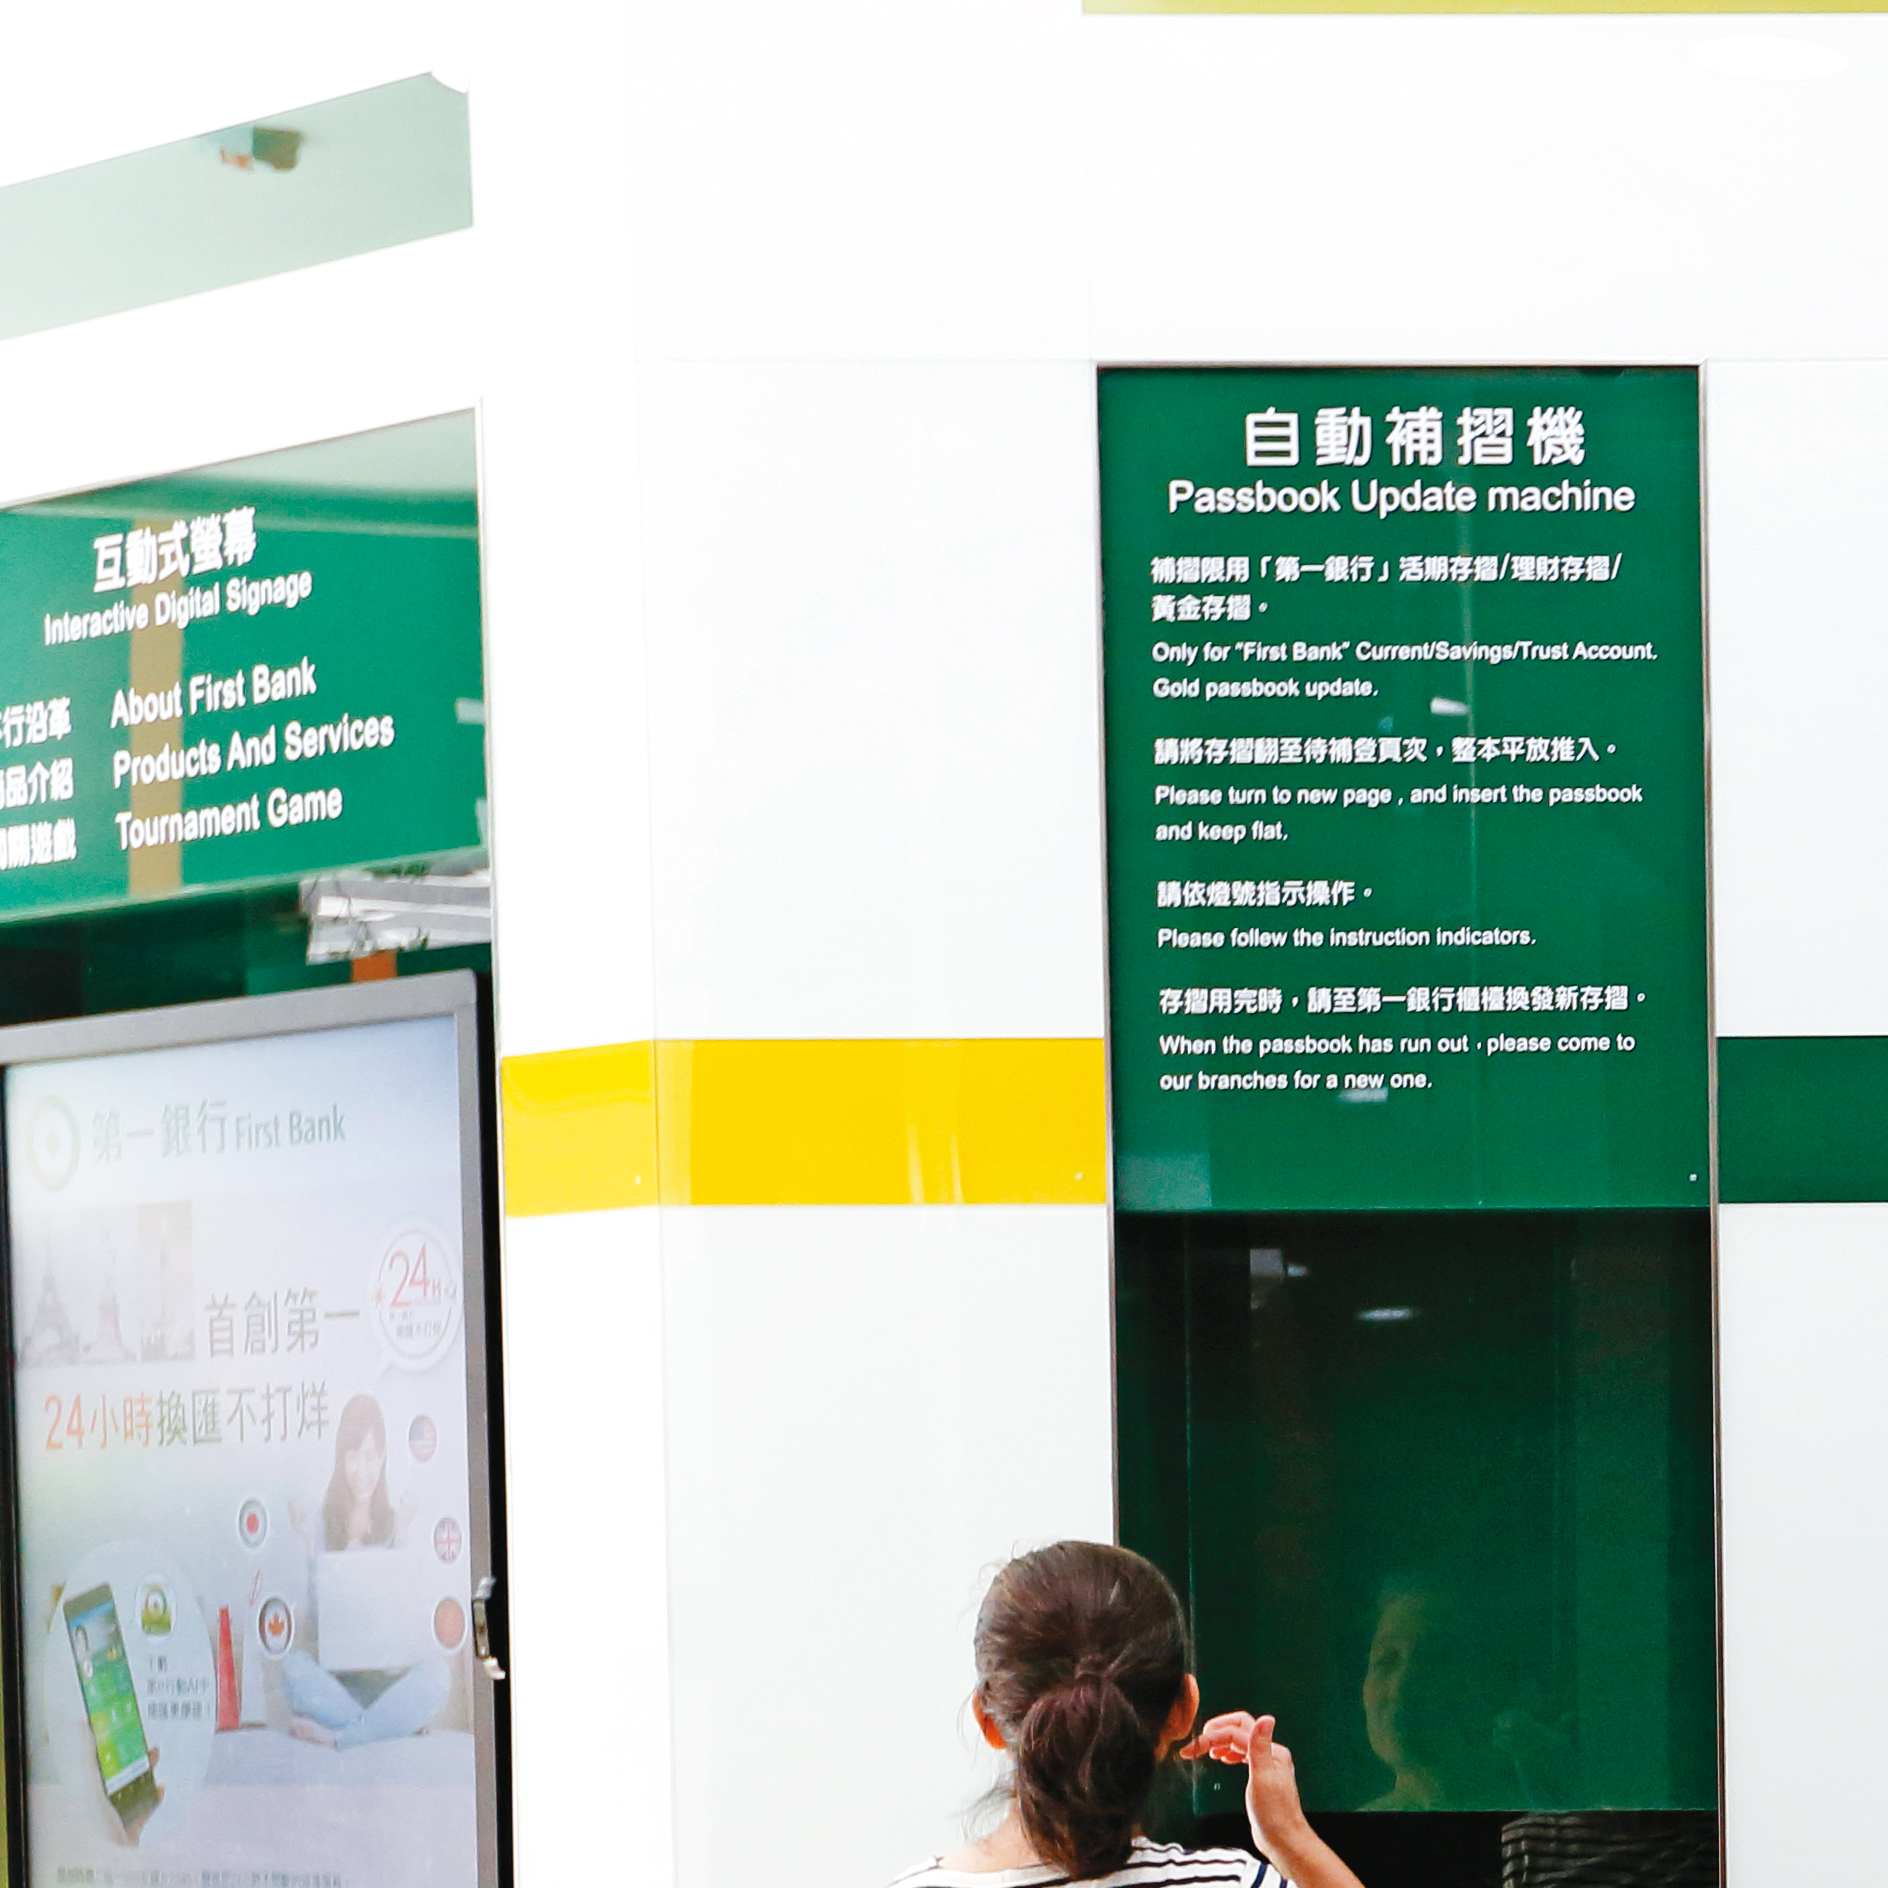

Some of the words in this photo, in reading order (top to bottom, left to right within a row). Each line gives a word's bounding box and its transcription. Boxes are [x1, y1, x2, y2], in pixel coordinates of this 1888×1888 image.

[1245, 405, 1585, 466] 自動補摺機
[1168, 479, 1341, 513] Passbook
[1351, 479, 1477, 520] Update
[1488, 479, 1635, 512] machine
[44, 600, 148, 645] Interactive
[155, 583, 220, 630] Digital
[226, 570, 313, 615] Signage
[1152, 641, 1199, 666] Only
[1202, 641, 1231, 662] for
[1572, 641, 1658, 660] Account.
[110, 682, 182, 728] About
[190, 670, 245, 712] First
[252, 656, 316, 701] Bank
[1152, 677, 1200, 698] Gold
[1205, 677, 1300, 702] passbook
[1304, 677, 1379, 701] update.
[0, 696, 71, 748] 行沿革
[113, 743, 221, 788] Products
[227, 725, 276, 771] And
[284, 713, 394, 762] Services
[0, 757, 74, 811] 品介紹
[1155, 785, 1223, 805] Please
[1228, 785, 1267, 805] turn
[1272, 785, 1292, 805] to
[1297, 788, 1338, 805] new
[1410, 784, 1447, 804] and
[1452, 784, 1508, 804] insert
[1511, 784, 1544, 803] the
[1548, 783, 1643, 807] passbook
[115, 794, 260, 851] Tournament
[267, 786, 343, 829] Game
[1155, 820, 1193, 841] and
[1198, 820, 1247, 845] keep
[1251, 820, 1288, 841] flat.
[1157, 928, 1225, 948] Please
[1230, 927, 1288, 947] follow
[1293, 927, 1324, 947] the
[1329, 927, 1430, 947] instruction
[1436, 926, 1537, 946] indicators.
[1159, 1035, 1216, 1055] When
[1222, 1034, 1253, 1054] the
[1259, 1034, 1353, 1058] passbook
[1358, 1034, 1394, 1054] has
[1400, 1037, 1432, 1053] run
[1487, 1032, 1552, 1056] please
[1557, 1036, 1611, 1052] come
[1616, 1033, 1636, 1051] to
[1159, 1074, 1193, 1090] our
[1198, 1070, 1288, 1090] branches
[1293, 1069, 1321, 1089] for
[1325, 1074, 1338, 1089] a
[1344, 1073, 1385, 1089] new
[1390, 1073, 1432, 1089] one.
[235, 1114, 281, 1150] First
[288, 1105, 346, 1146] Bank
